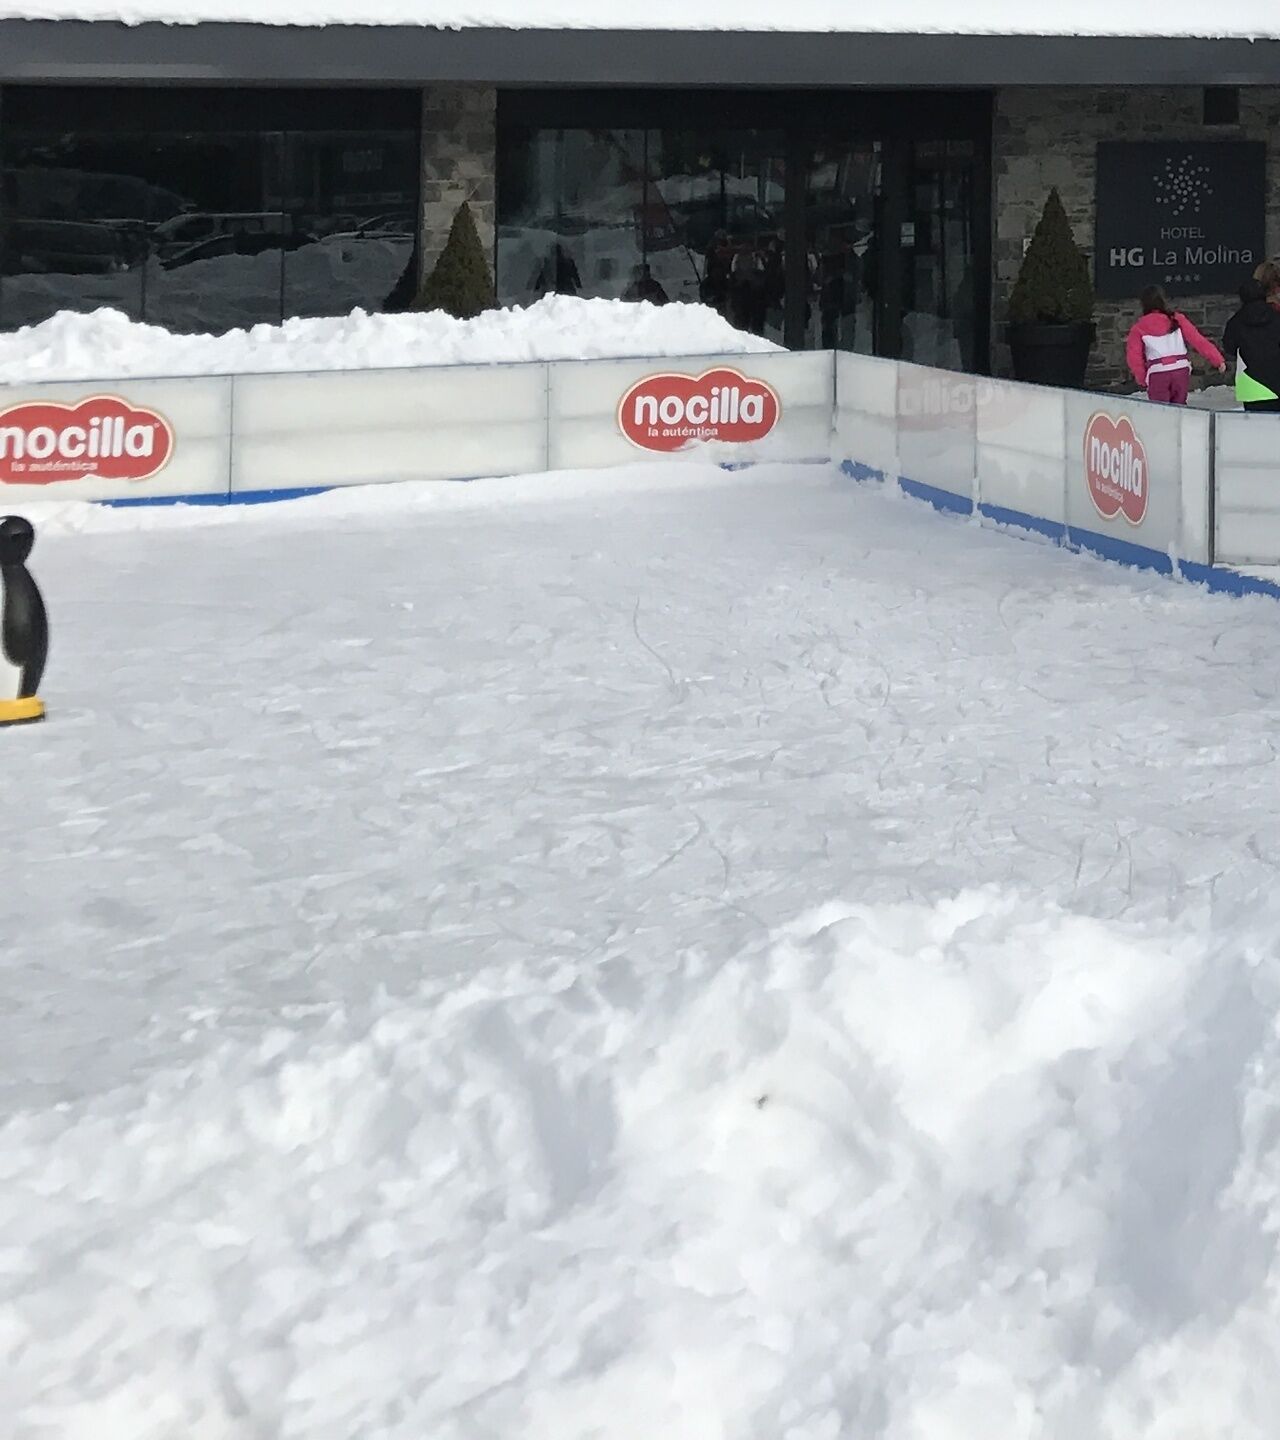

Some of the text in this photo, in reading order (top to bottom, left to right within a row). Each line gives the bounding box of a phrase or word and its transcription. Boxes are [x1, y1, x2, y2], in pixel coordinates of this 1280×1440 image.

[1160, 227, 1206, 240] HOTEL
[1109, 244, 1253, 267] HG La Molina
[634, 386, 764, 426] nocilla
[0, 416, 154, 460] nocilla
[647, 426, 719, 438] la auténtica
[1090, 435, 1143, 498] nocilla
